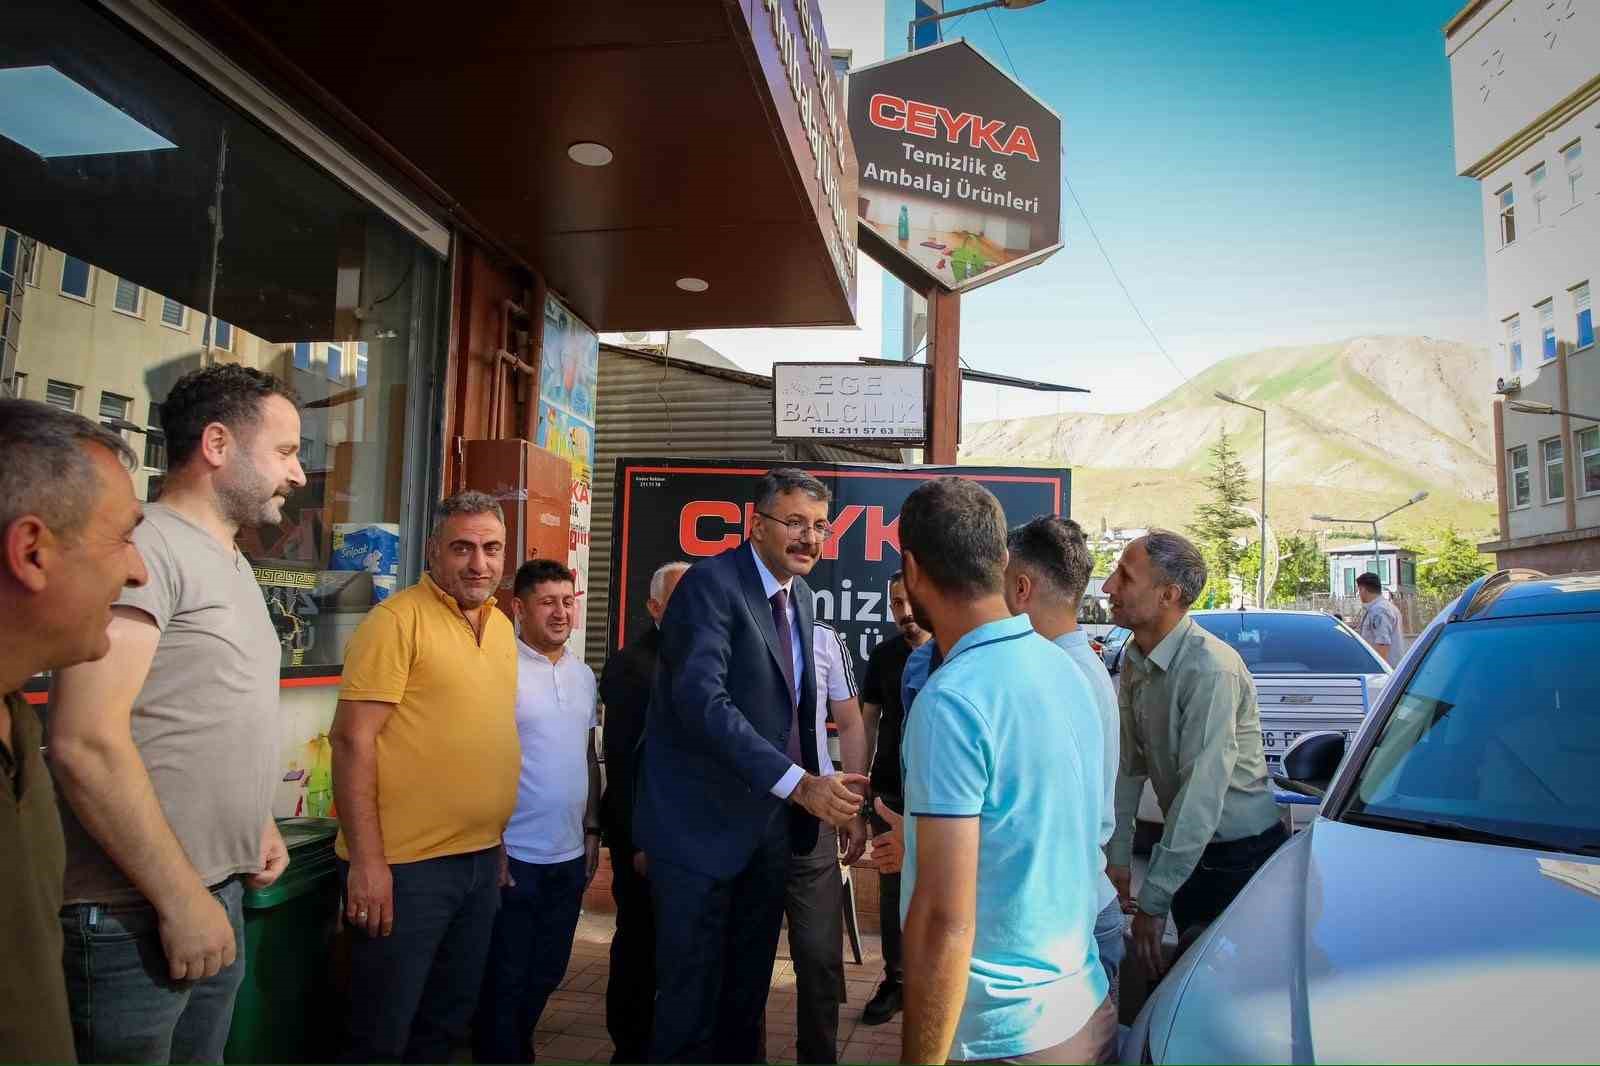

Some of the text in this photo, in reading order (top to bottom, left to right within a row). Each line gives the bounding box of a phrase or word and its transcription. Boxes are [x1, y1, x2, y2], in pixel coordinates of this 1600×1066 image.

[869, 93, 1040, 163] CEYKA
[902, 142, 1007, 181] Temizlik &
[863, 162, 1039, 214] Ambalaj Ürünleri
[815, 375, 883, 396] EGE
[810, 427, 835, 435] TEL:
[839, 427, 858, 435] 211
[864, 427, 877, 435] 57
[880, 427, 894, 435] 63
